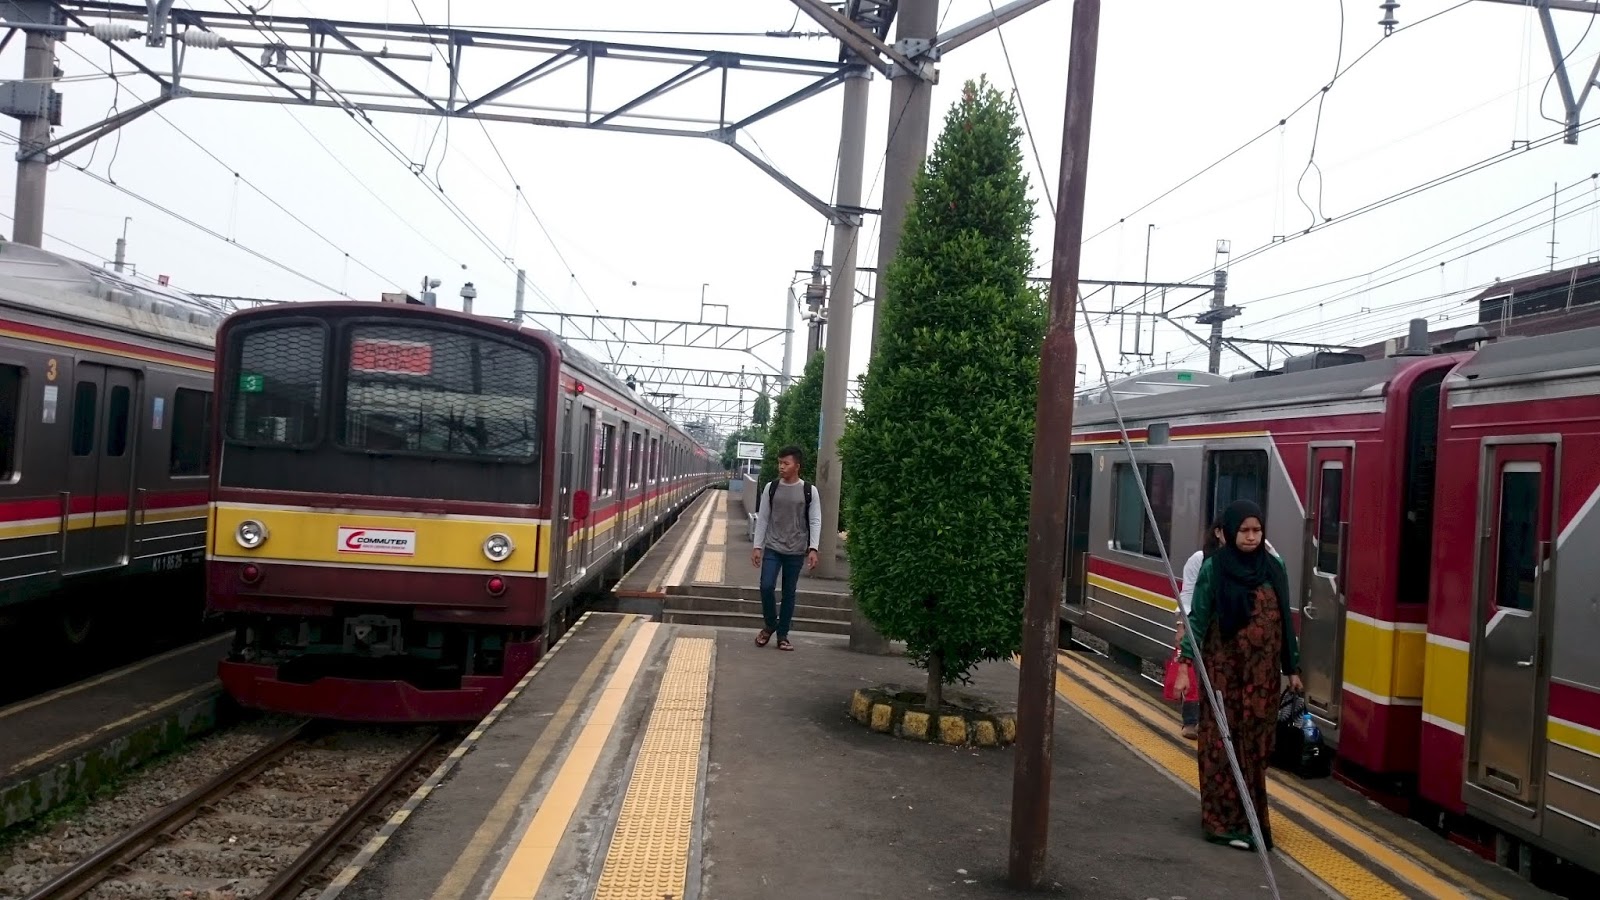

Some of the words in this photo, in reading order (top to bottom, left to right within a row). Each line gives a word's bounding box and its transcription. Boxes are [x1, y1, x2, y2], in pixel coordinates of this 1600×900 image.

[47, 358, 57, 381] 3
[247, 375, 256, 390] 3
[1100, 455, 1104, 472] 9
[357, 537, 408, 545] COMMUTER
